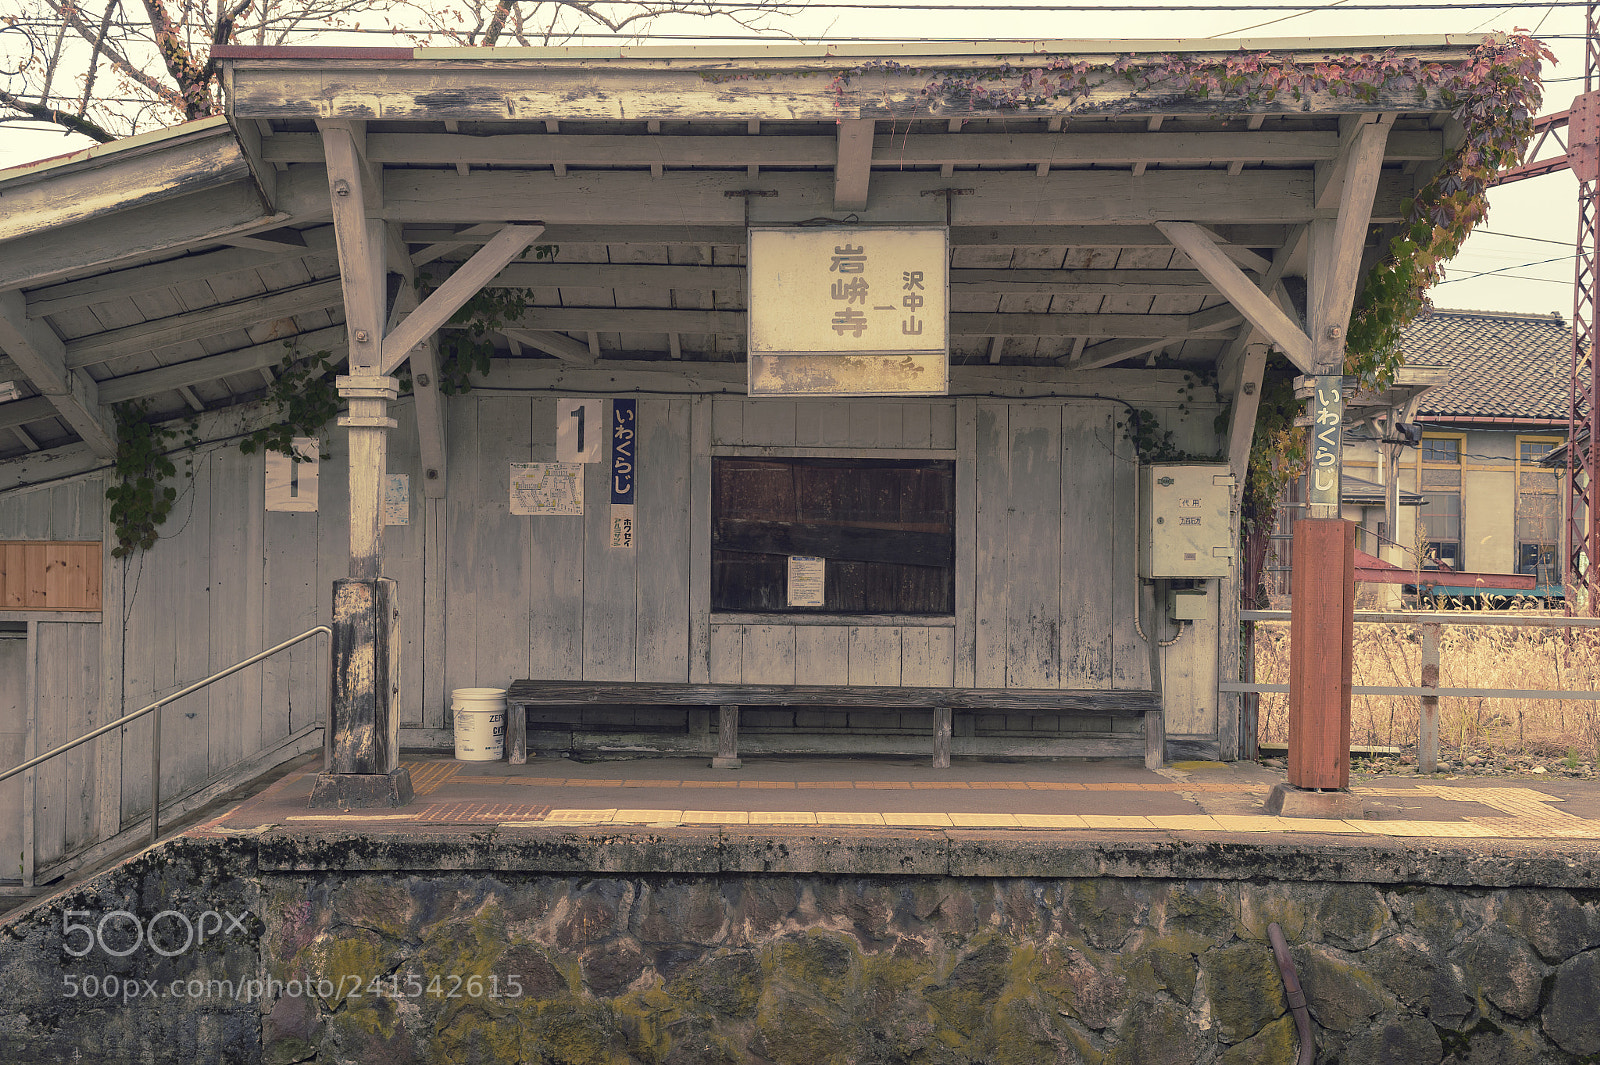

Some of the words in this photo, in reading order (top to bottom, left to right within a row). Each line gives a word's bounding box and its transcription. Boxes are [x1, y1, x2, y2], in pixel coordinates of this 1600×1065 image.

[901, 270, 925, 336] 沢中山
[570, 405, 585, 453] 1
[613, 409, 634, 495] いわくらじ
[1315, 388, 1340, 491] いわくらじ
[623, 518, 632, 547] ホクセイ
